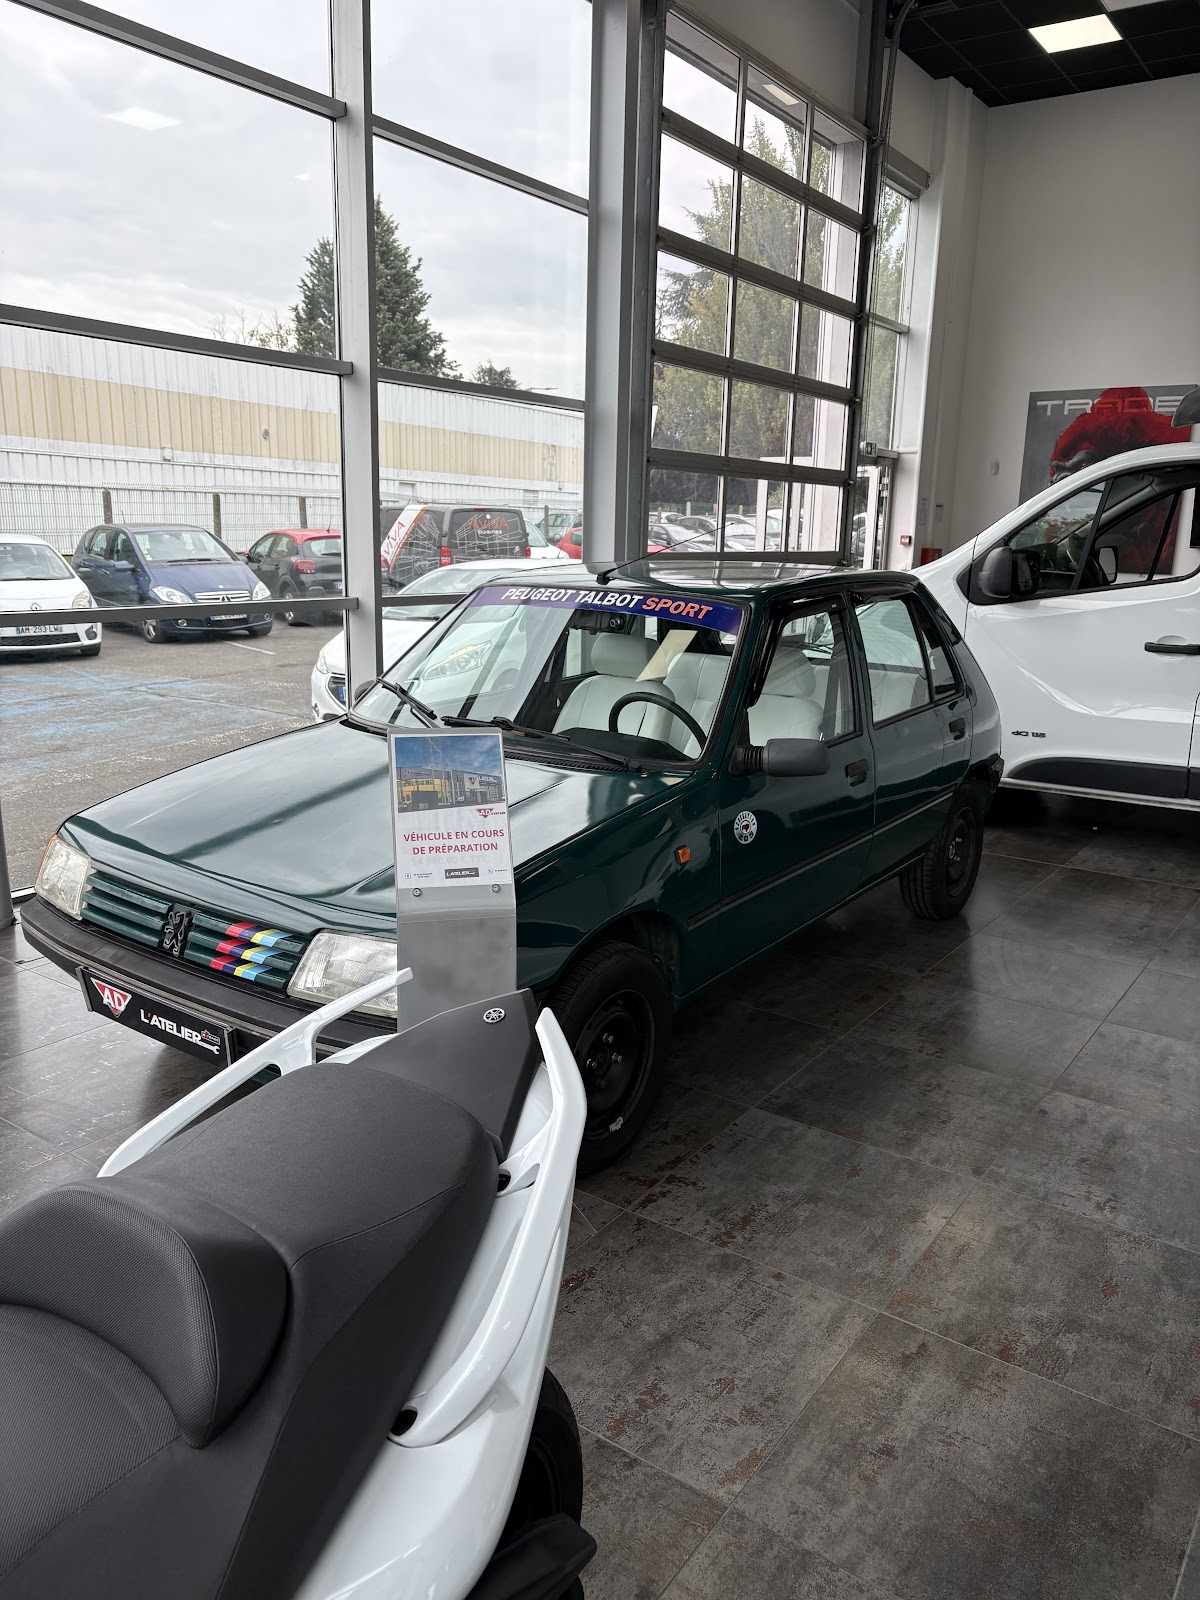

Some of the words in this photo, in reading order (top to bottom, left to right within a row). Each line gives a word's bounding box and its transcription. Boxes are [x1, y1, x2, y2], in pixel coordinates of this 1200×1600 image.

[468, 516, 509, 529] AVIVA
[501, 588, 573, 602] PEUGEOT
[574, 591, 643, 609] TALBOT
[642, 597, 713, 620] SPORT
[404, 832, 452, 842] VÉHICULE
[455, 831, 469, 839] EN
[471, 828, 505, 838] COURS
[412, 846, 426, 855] DE
[428, 842, 498, 854] PRÉPARATION
[102, 987, 126, 1012] AD
[140, 1009, 202, 1044] L'ATELIER
